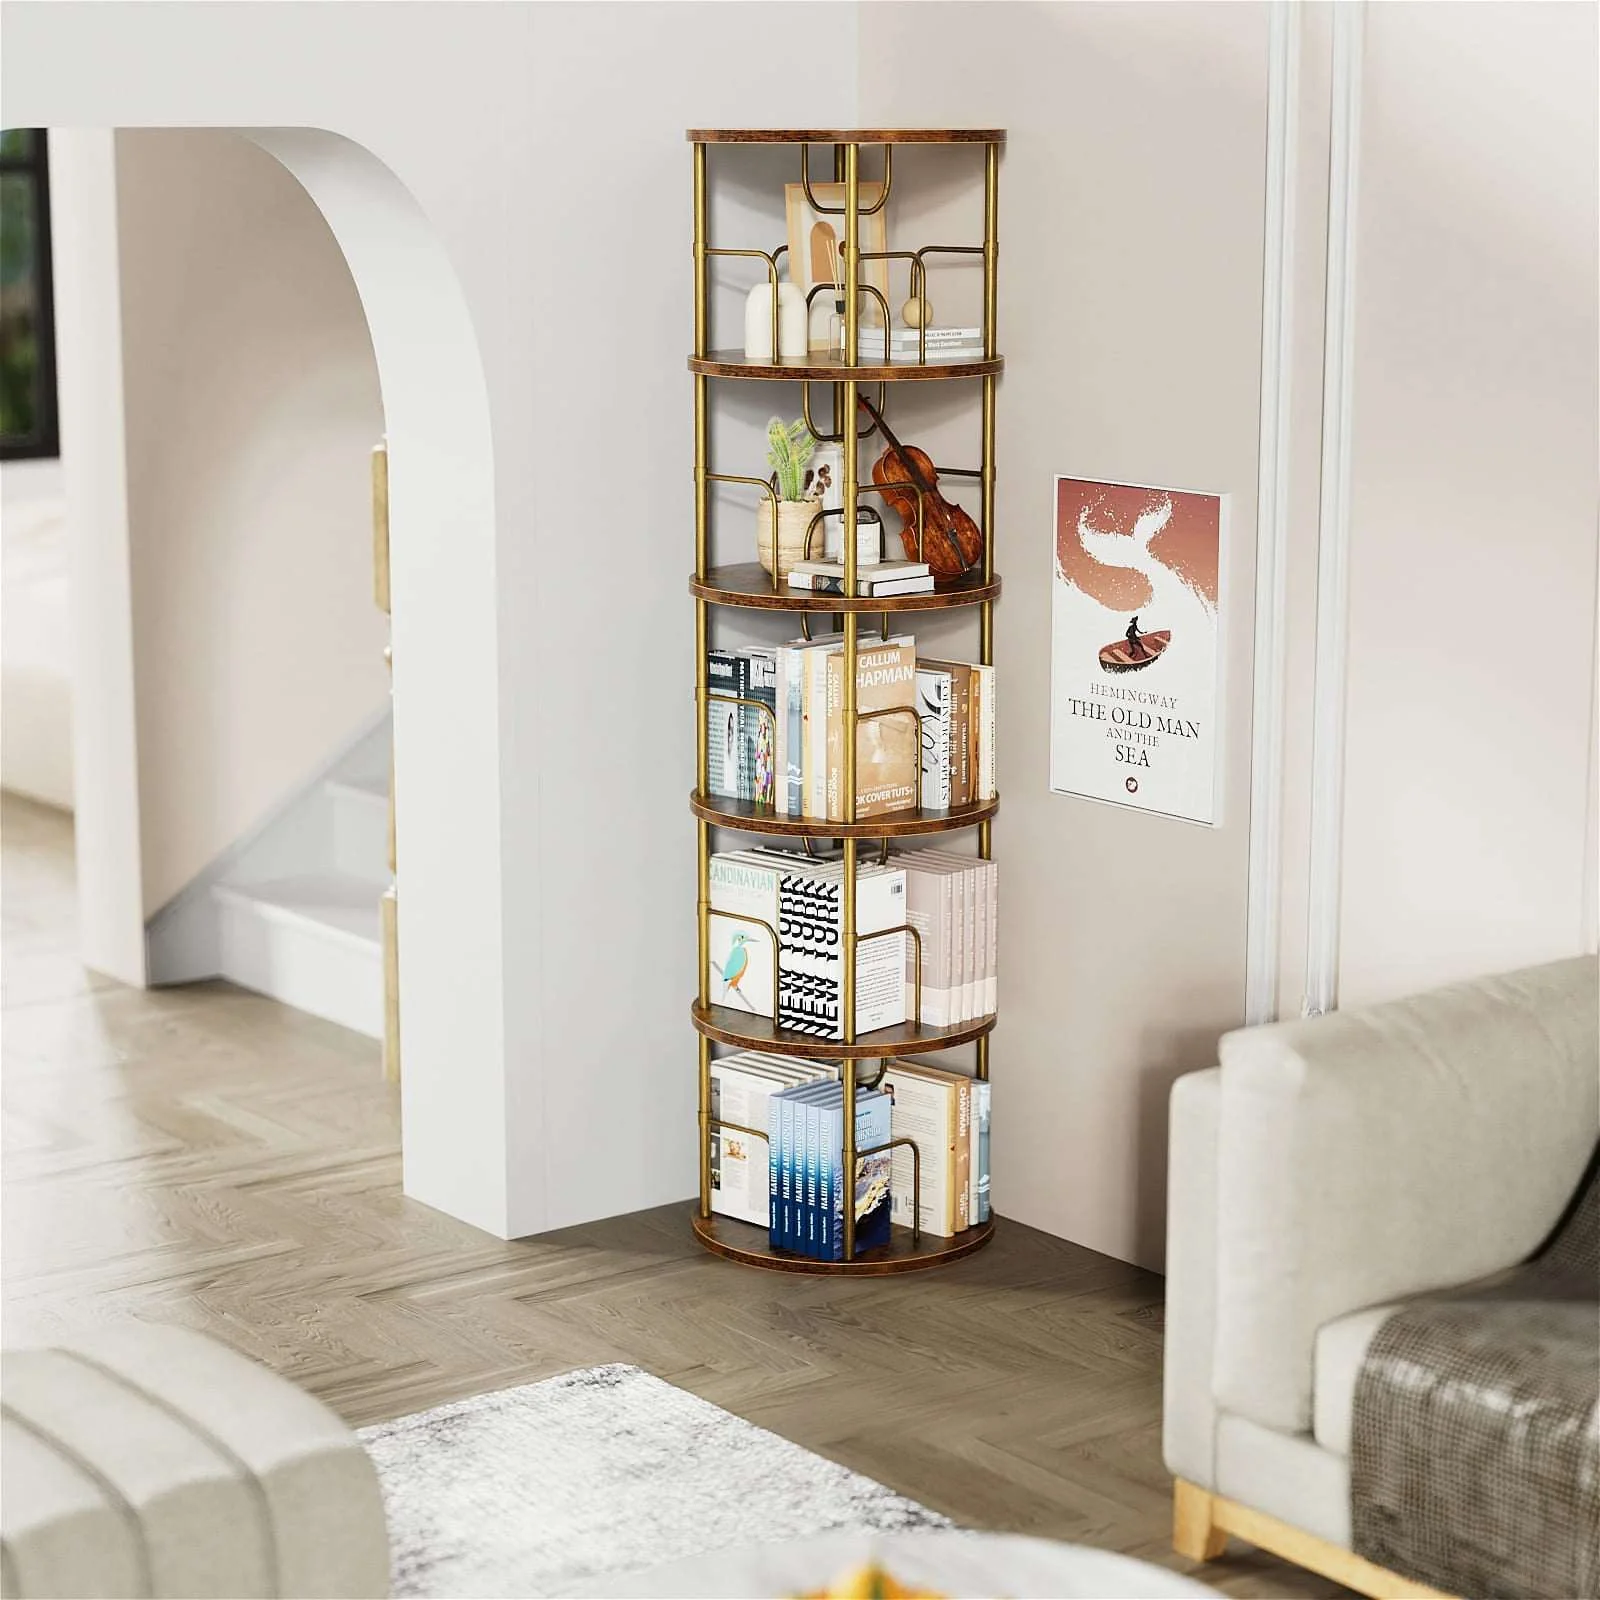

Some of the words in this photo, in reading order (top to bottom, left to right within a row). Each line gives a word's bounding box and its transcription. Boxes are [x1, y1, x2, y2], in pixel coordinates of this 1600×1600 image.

[860, 651, 901, 669] CALLUM
[856, 665, 914, 689] HAPMAN
[1089, 682, 1178, 710] HEMINGWAY
[1068, 697, 1107, 721] THE
[1111, 707, 1152, 729] OLD
[1156, 716, 1201, 740] MAN
[1106, 727, 1132, 741] AND
[1134, 732, 1160, 748] THE
[1115, 744, 1151, 768] SEA
[866, 790, 892, 804] COVER
[891, 785, 913, 799] TUTS+
[709, 862, 775, 893] CANDINAVIAN
[780, 967, 792, 1028] NEW
[791, 970, 804, 1031] NEW
[803, 973, 815, 1034] NEW
[815, 976, 827, 1036] NEW
[826, 978, 839, 1039] NEW
